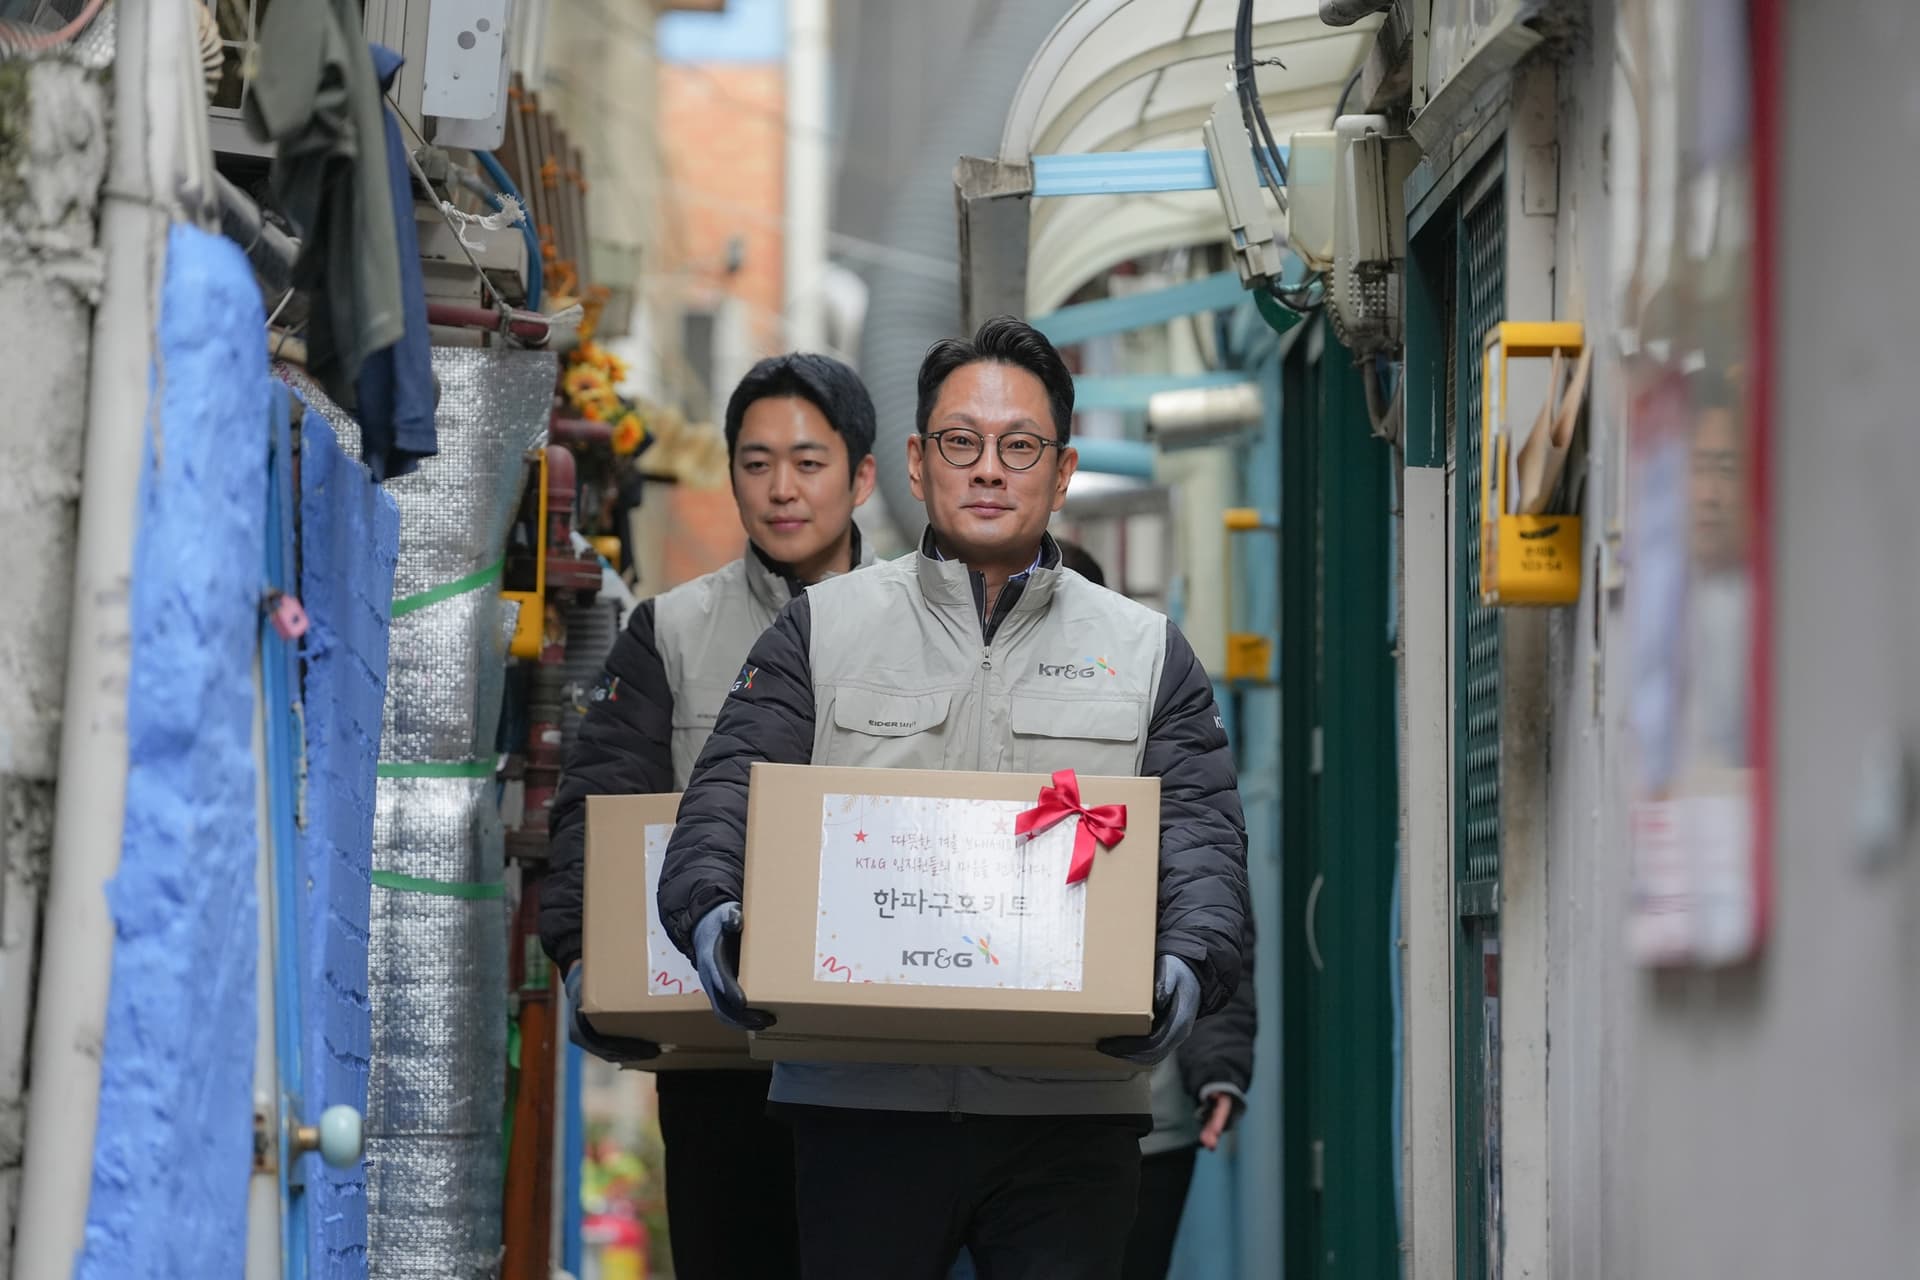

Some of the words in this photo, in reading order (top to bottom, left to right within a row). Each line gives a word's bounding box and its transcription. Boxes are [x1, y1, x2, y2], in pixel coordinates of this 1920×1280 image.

[1039, 663, 1095, 680] KT&G
[867, 718, 899, 728] EIDER
[890, 832, 931, 851] 따뜻한
[855, 856, 887, 871] KT&G
[892, 856, 950, 877] 임직원들의
[873, 888, 1032, 918] 한파구호키트
[902, 947, 973, 969] KT&G
